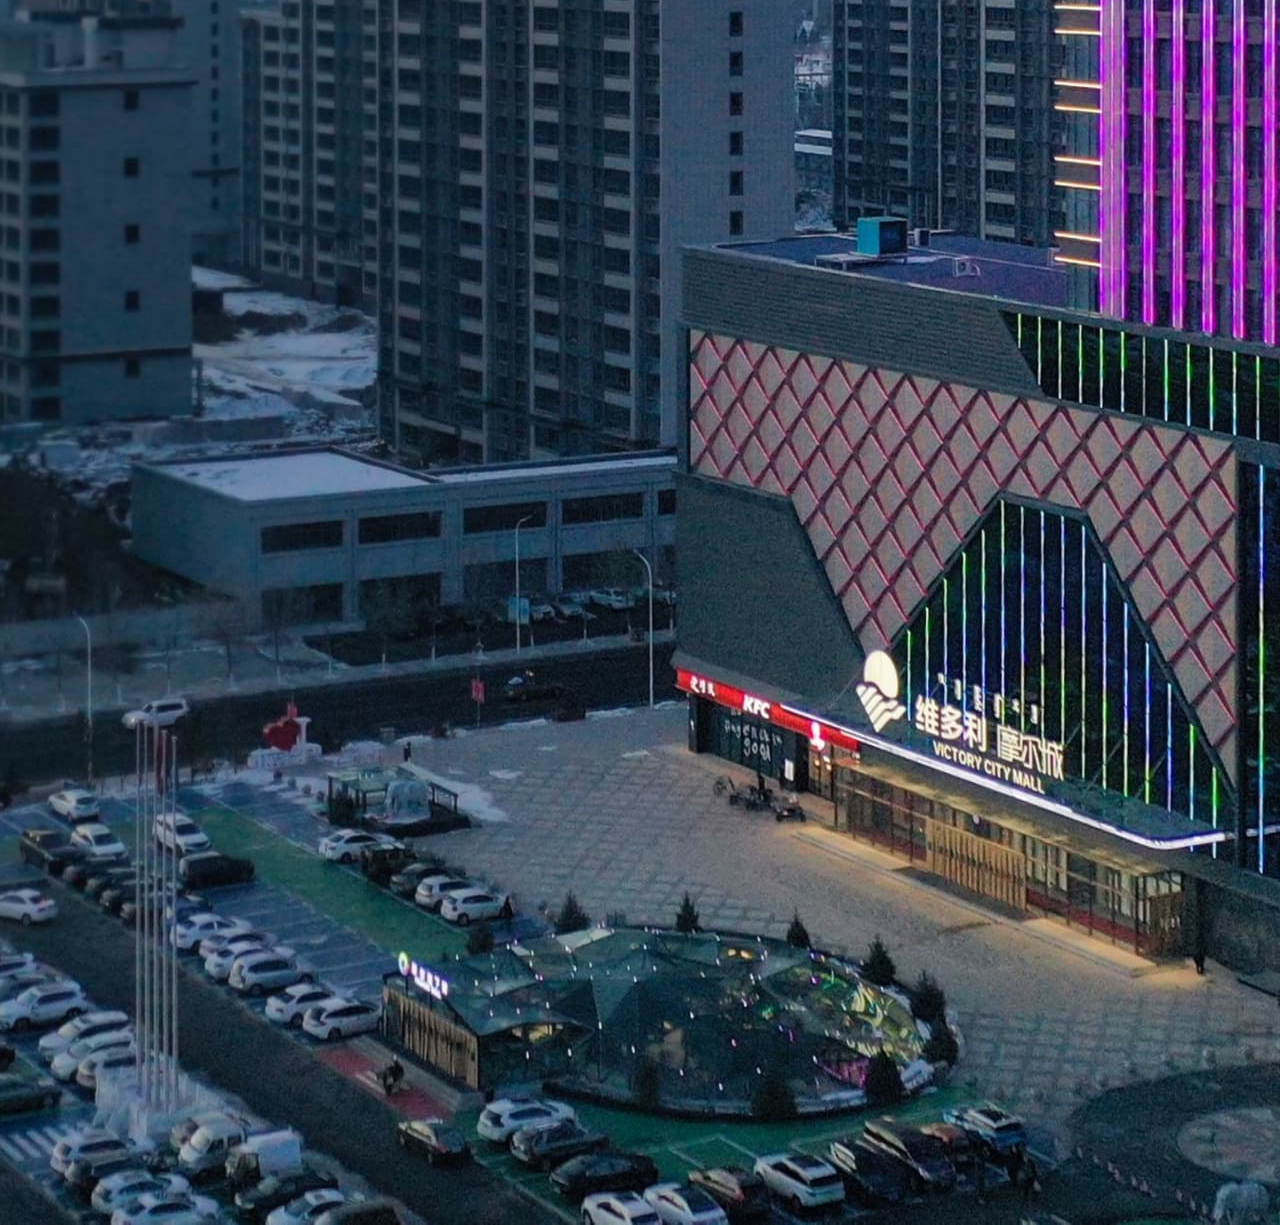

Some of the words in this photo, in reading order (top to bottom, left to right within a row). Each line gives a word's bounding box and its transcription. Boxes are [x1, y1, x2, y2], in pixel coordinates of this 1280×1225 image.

[742, 693, 770, 720] KFC
[915, 693, 988, 753] 维多利
[932, 739, 982, 771] VICTORY
[983, 760, 1012, 783] CITY
[1012, 771, 1046, 795] MALL
